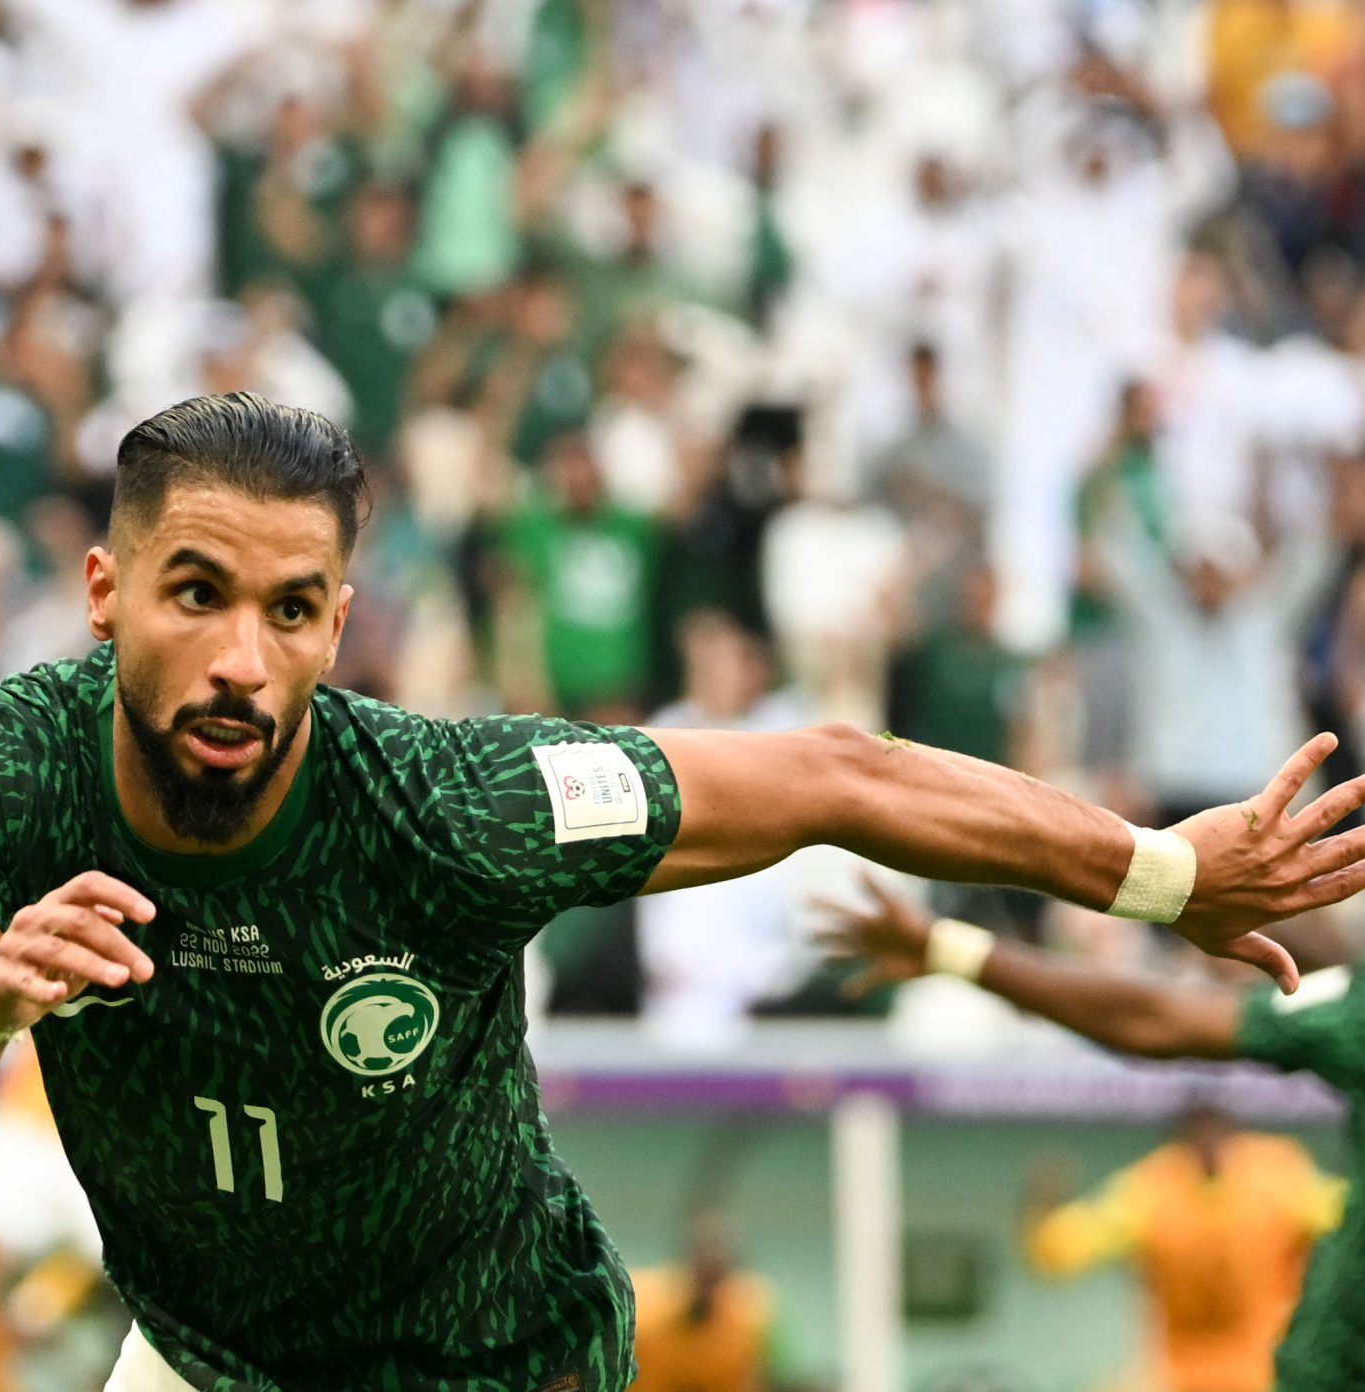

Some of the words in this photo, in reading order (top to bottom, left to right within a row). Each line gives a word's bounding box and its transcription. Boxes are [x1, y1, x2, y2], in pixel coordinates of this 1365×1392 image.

[593, 766, 613, 804] UNITES
[180, 932, 198, 949] 22
[203, 936, 228, 955] NOV
[232, 943, 271, 959] 2022
[230, 924, 260, 943] KSA
[171, 949, 217, 971] LUSAIL
[222, 957, 284, 975] STADIUM
[321, 951, 415, 981] السعودية
[387, 1027, 420, 1044] SAFF
[361, 1073, 416, 1099] KSA
[193, 1095, 284, 1204] 11
